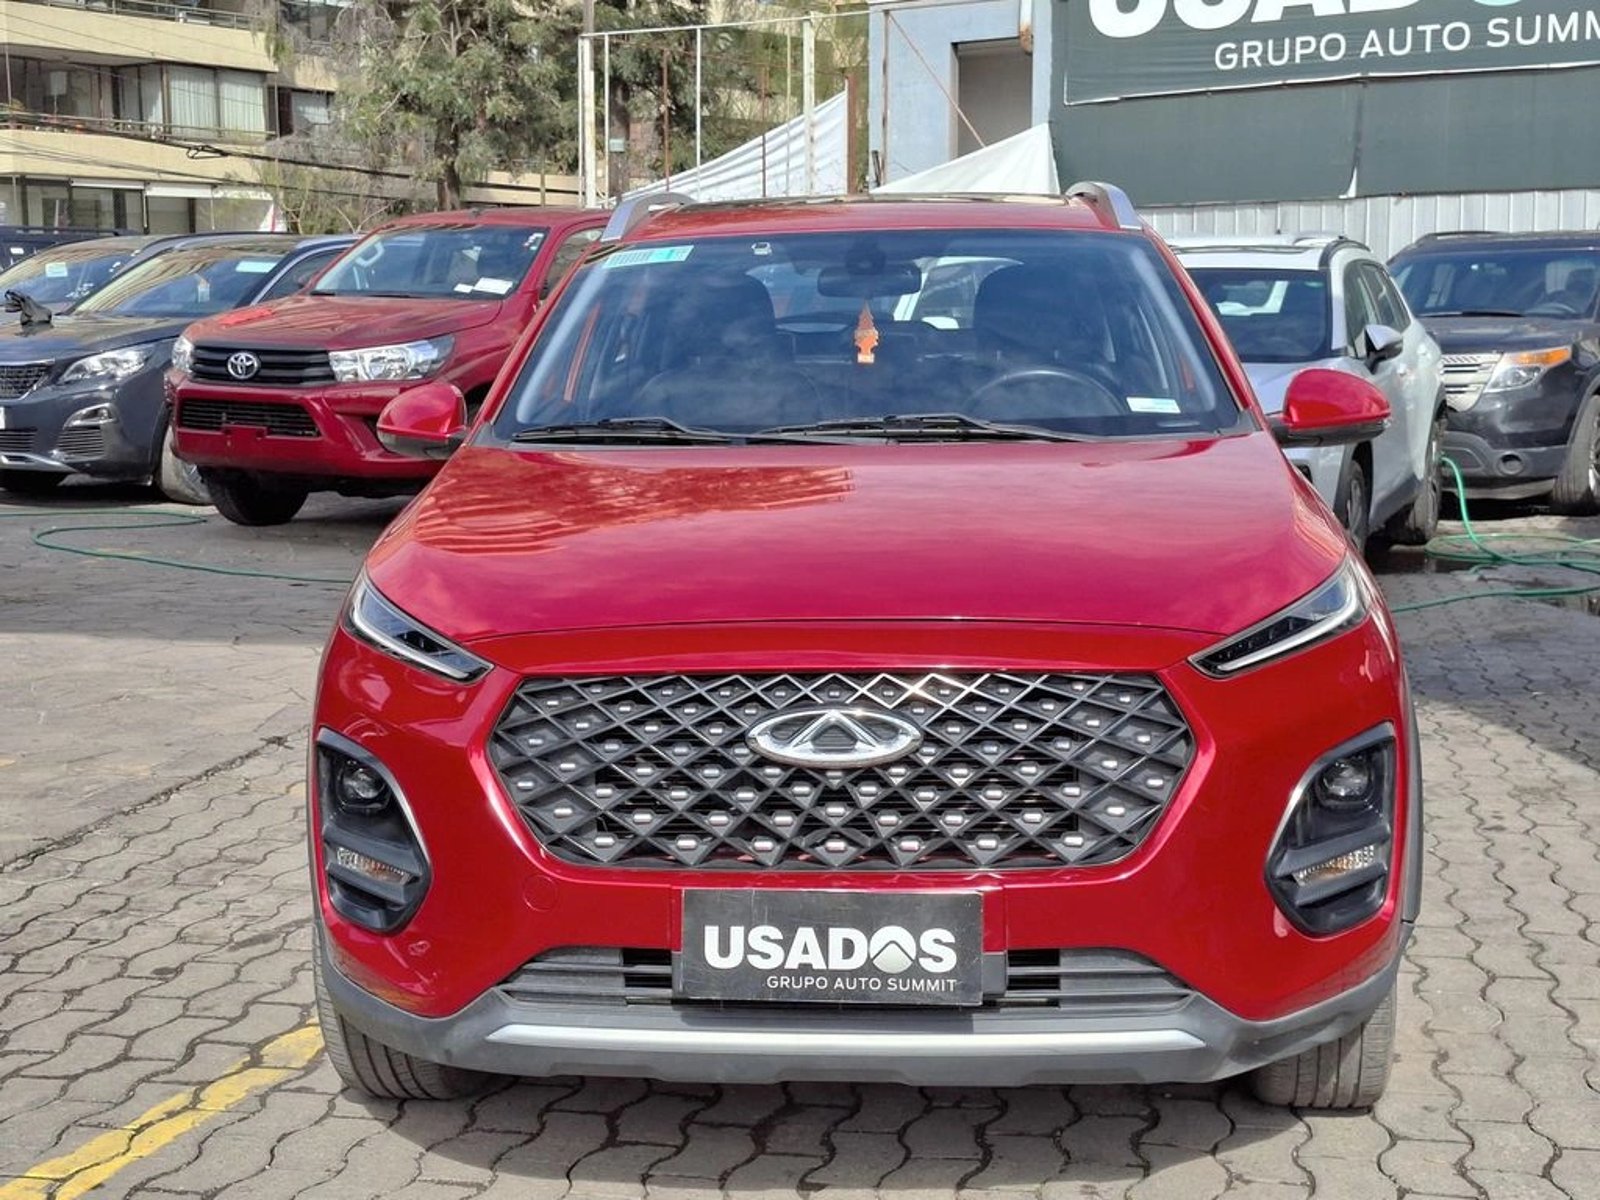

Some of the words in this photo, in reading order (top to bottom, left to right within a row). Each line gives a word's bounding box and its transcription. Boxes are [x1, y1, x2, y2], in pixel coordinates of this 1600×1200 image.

[1215, 32, 1347, 70] GRUPO
[1360, 21, 1471, 58] AUTO
[704, 925, 957, 973] USADOS
[767, 976, 828, 989] GRUPO
[833, 977, 882, 990] AUTO
[887, 978, 957, 992] SUMMIT
